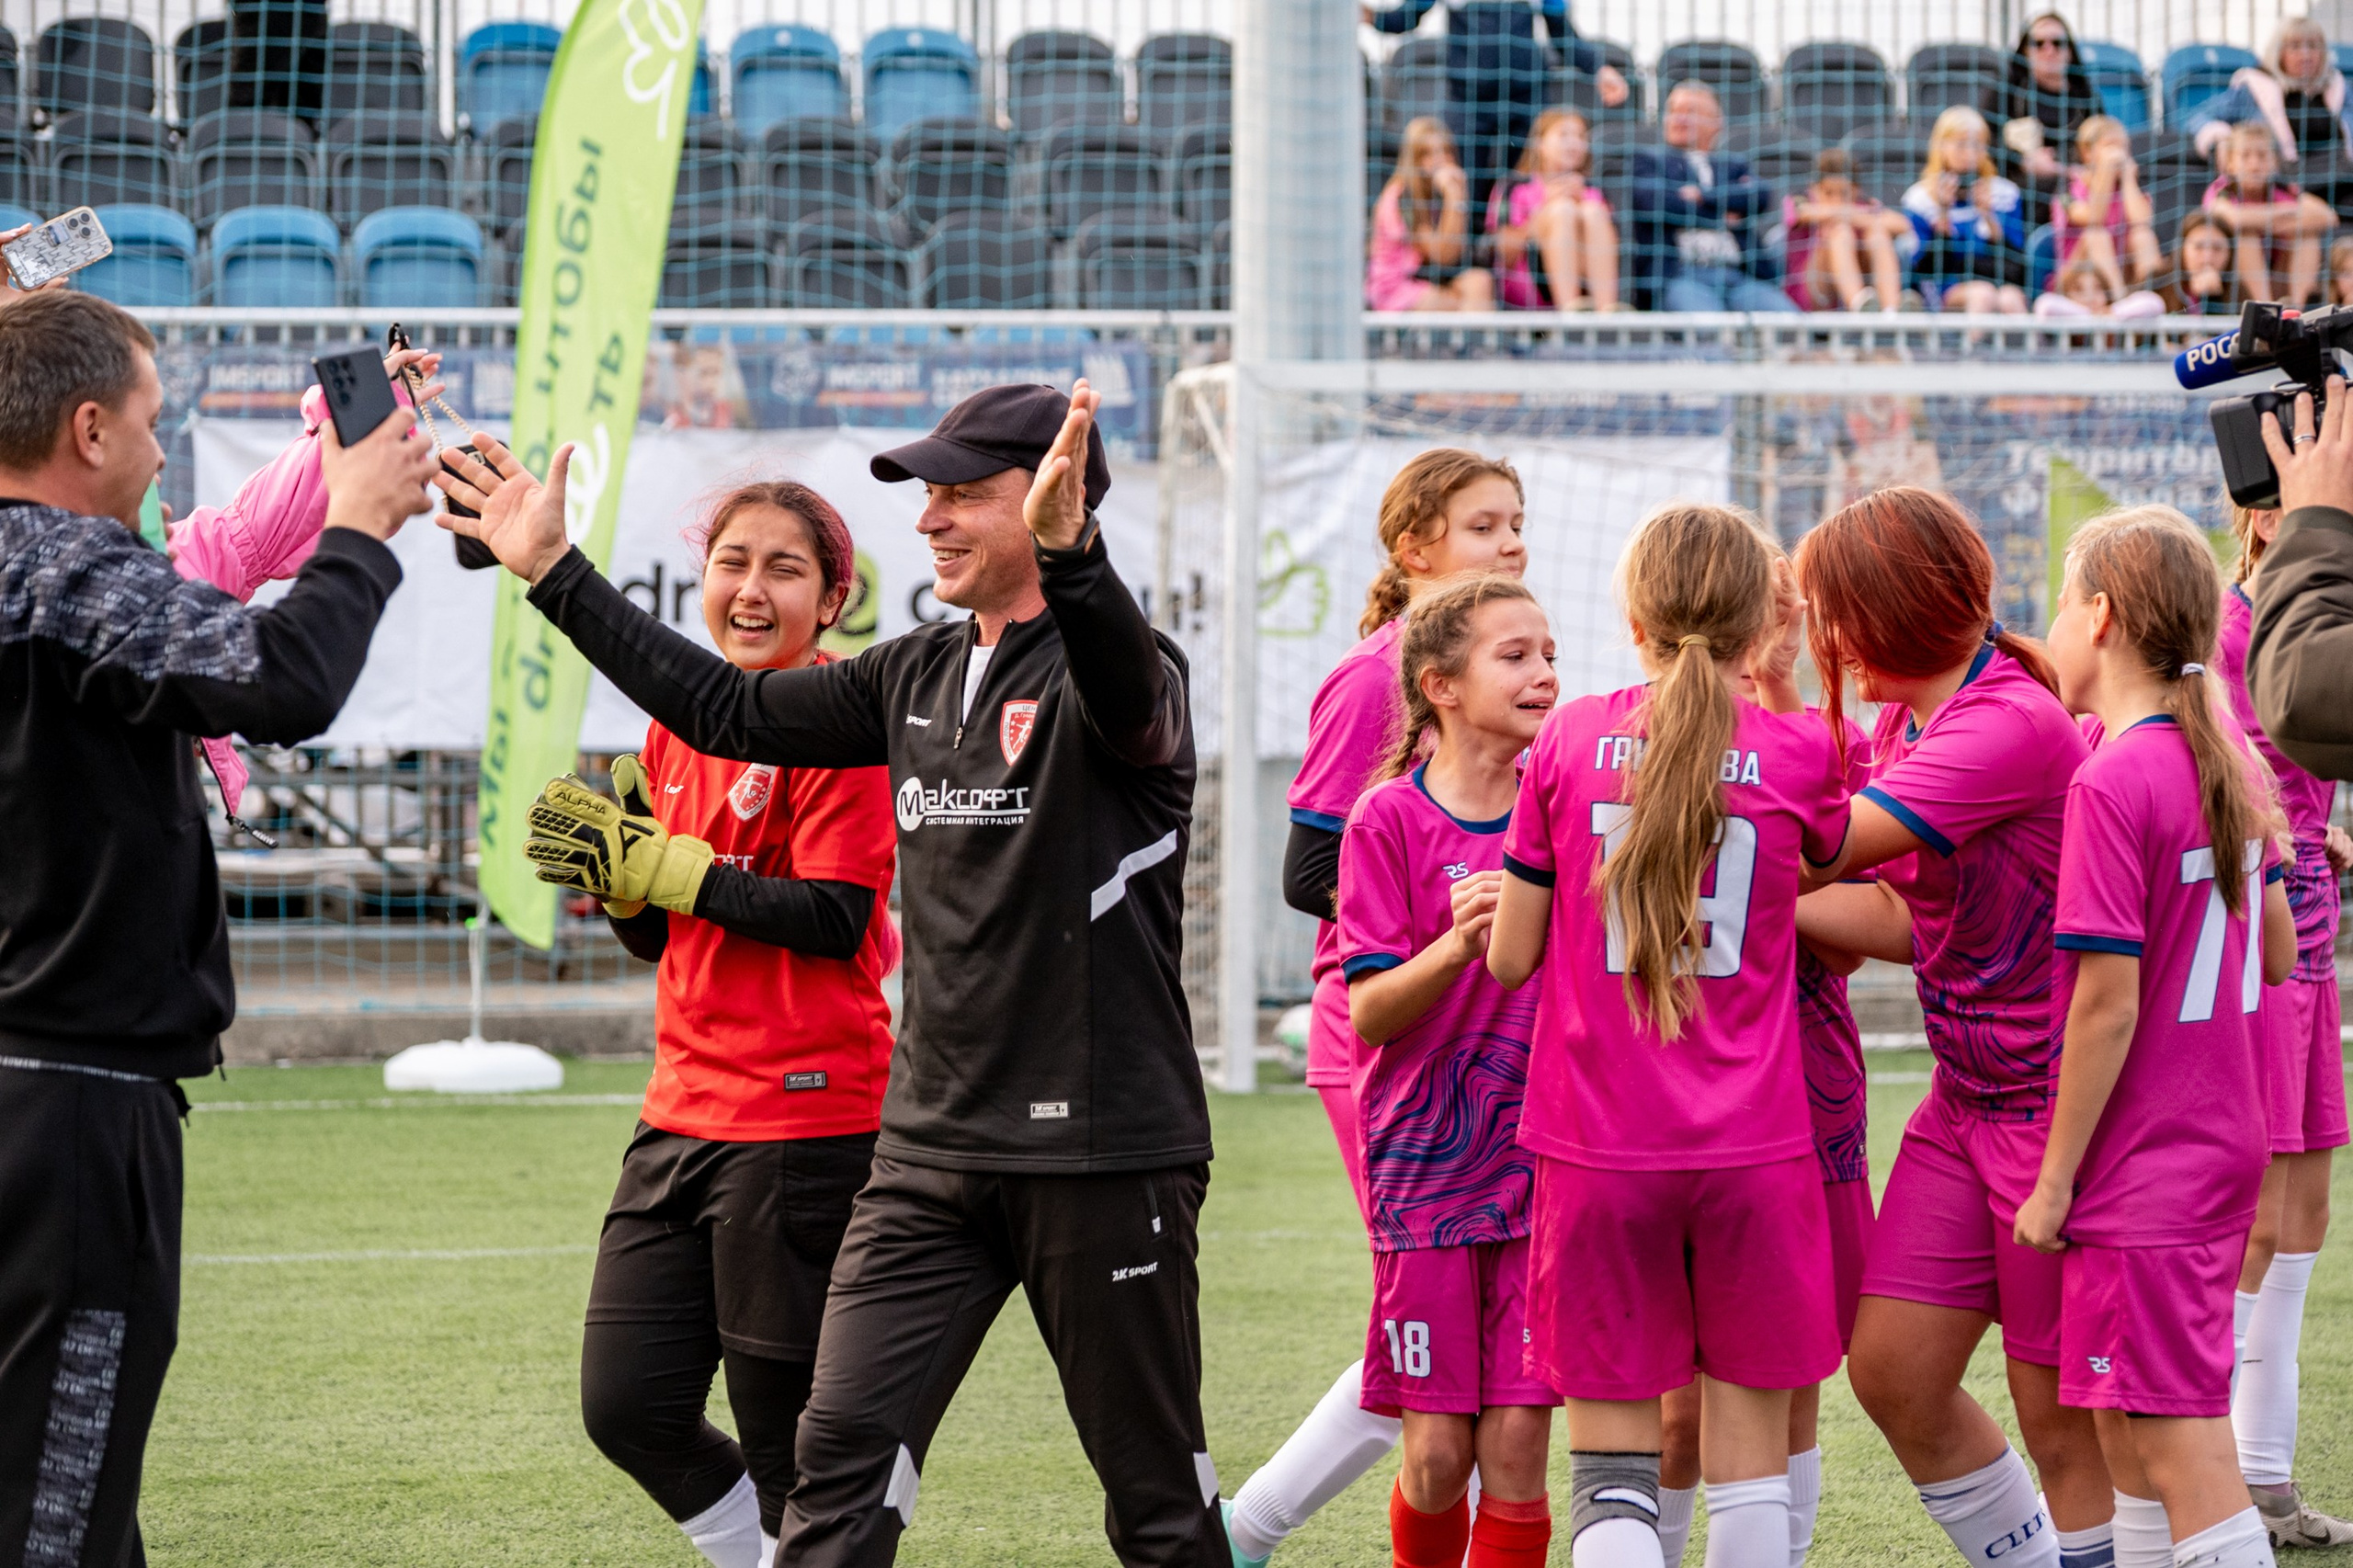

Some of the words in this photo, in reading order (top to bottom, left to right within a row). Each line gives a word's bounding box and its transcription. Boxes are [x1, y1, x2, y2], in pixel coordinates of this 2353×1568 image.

[555, 790, 607, 815] ALPHA
[926, 816, 964, 825] СИСТЕМНАЯ
[966, 815, 1024, 826] ИНТЕГРАЦИЯ
[1128, 1261, 1158, 1278] SPORT
[1384, 1317, 1432, 1379] 18
